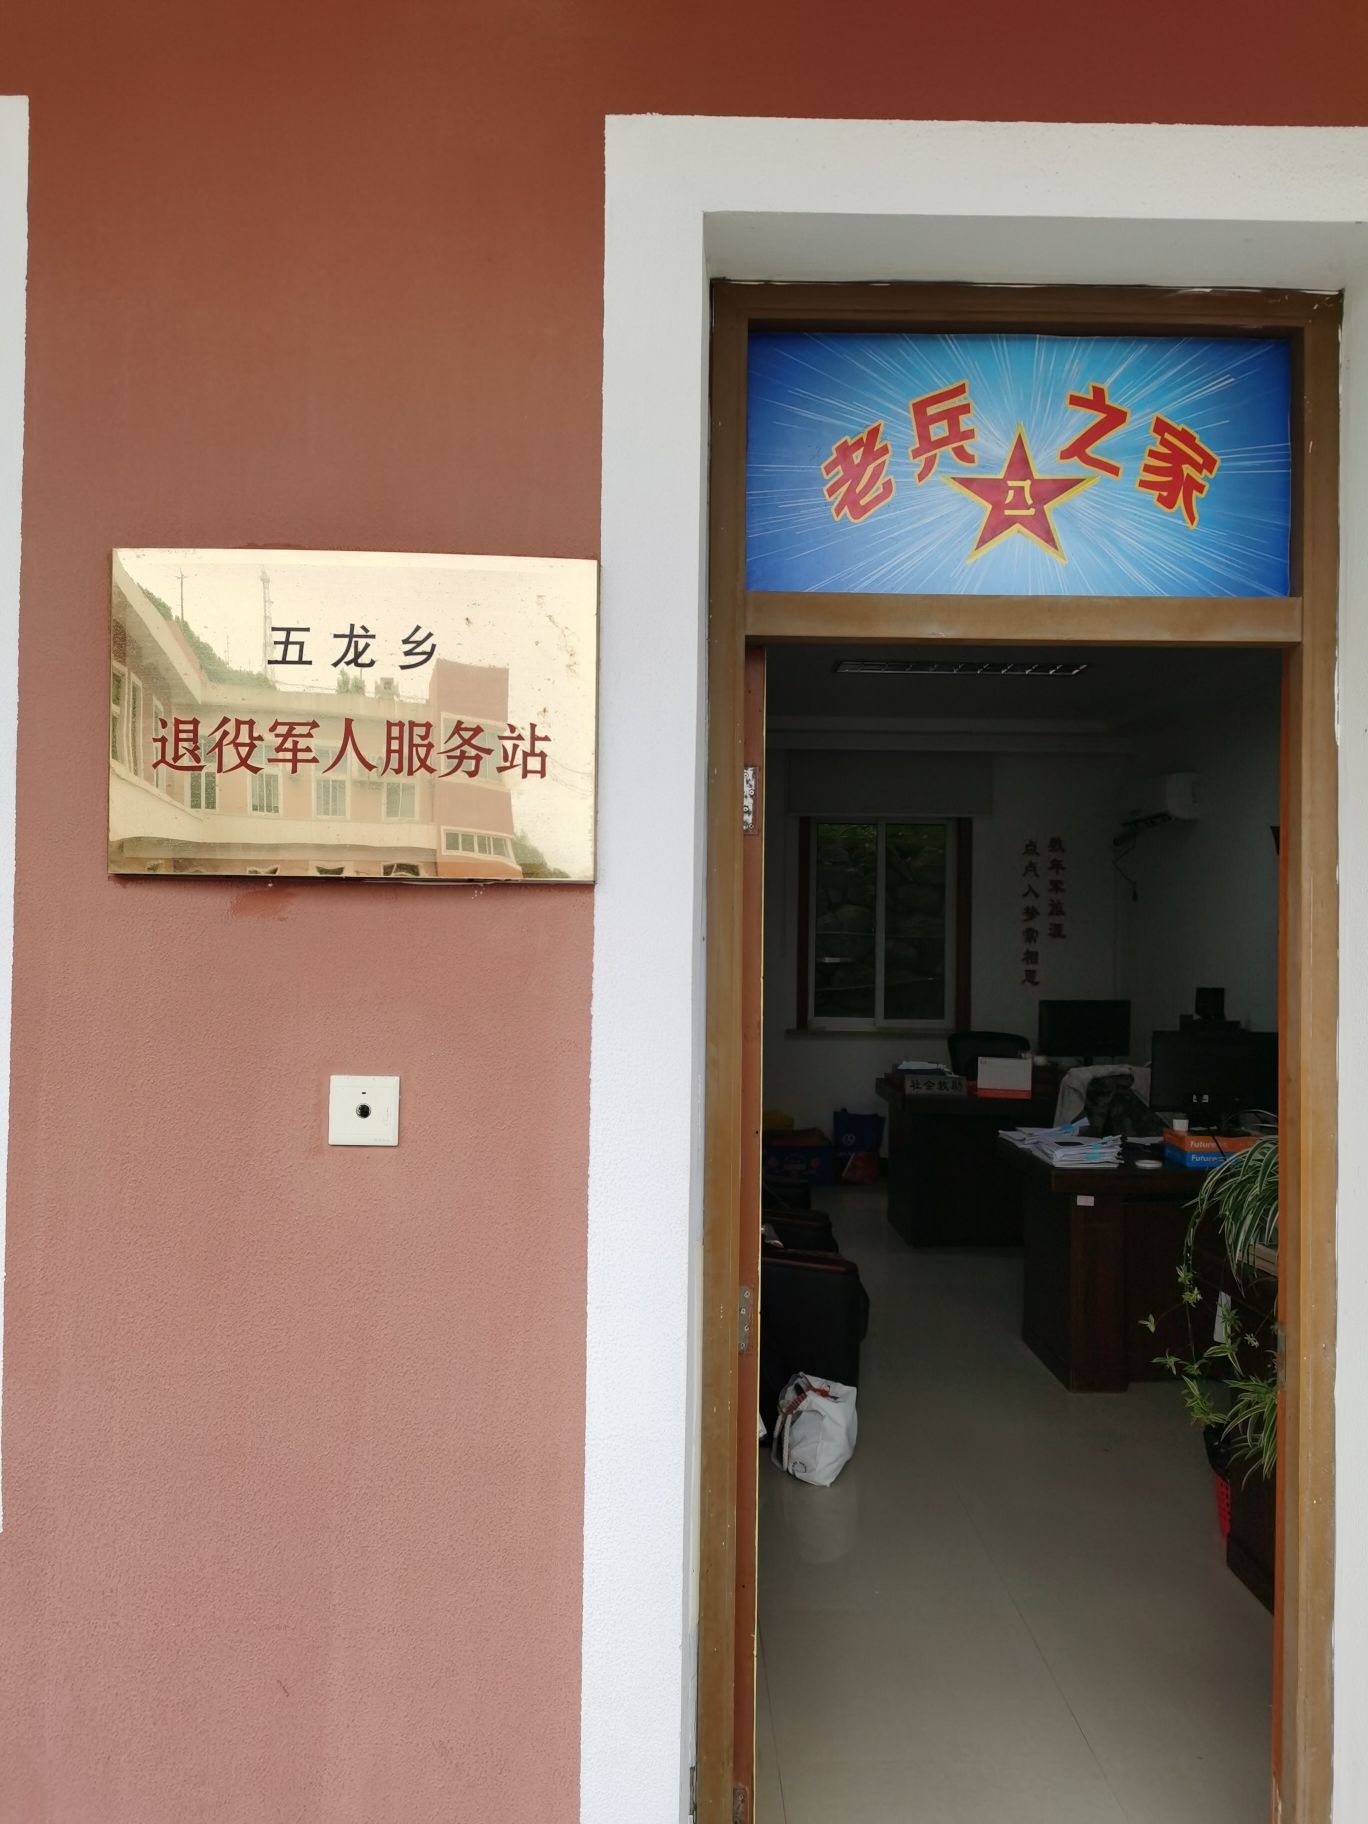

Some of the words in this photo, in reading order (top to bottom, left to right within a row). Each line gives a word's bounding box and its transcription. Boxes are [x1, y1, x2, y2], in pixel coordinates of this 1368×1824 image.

[821, 377, 1221, 530] 老兵之家
[267, 622, 438, 670] 五龙乡
[152, 715, 552, 780] 退役军人服务站
